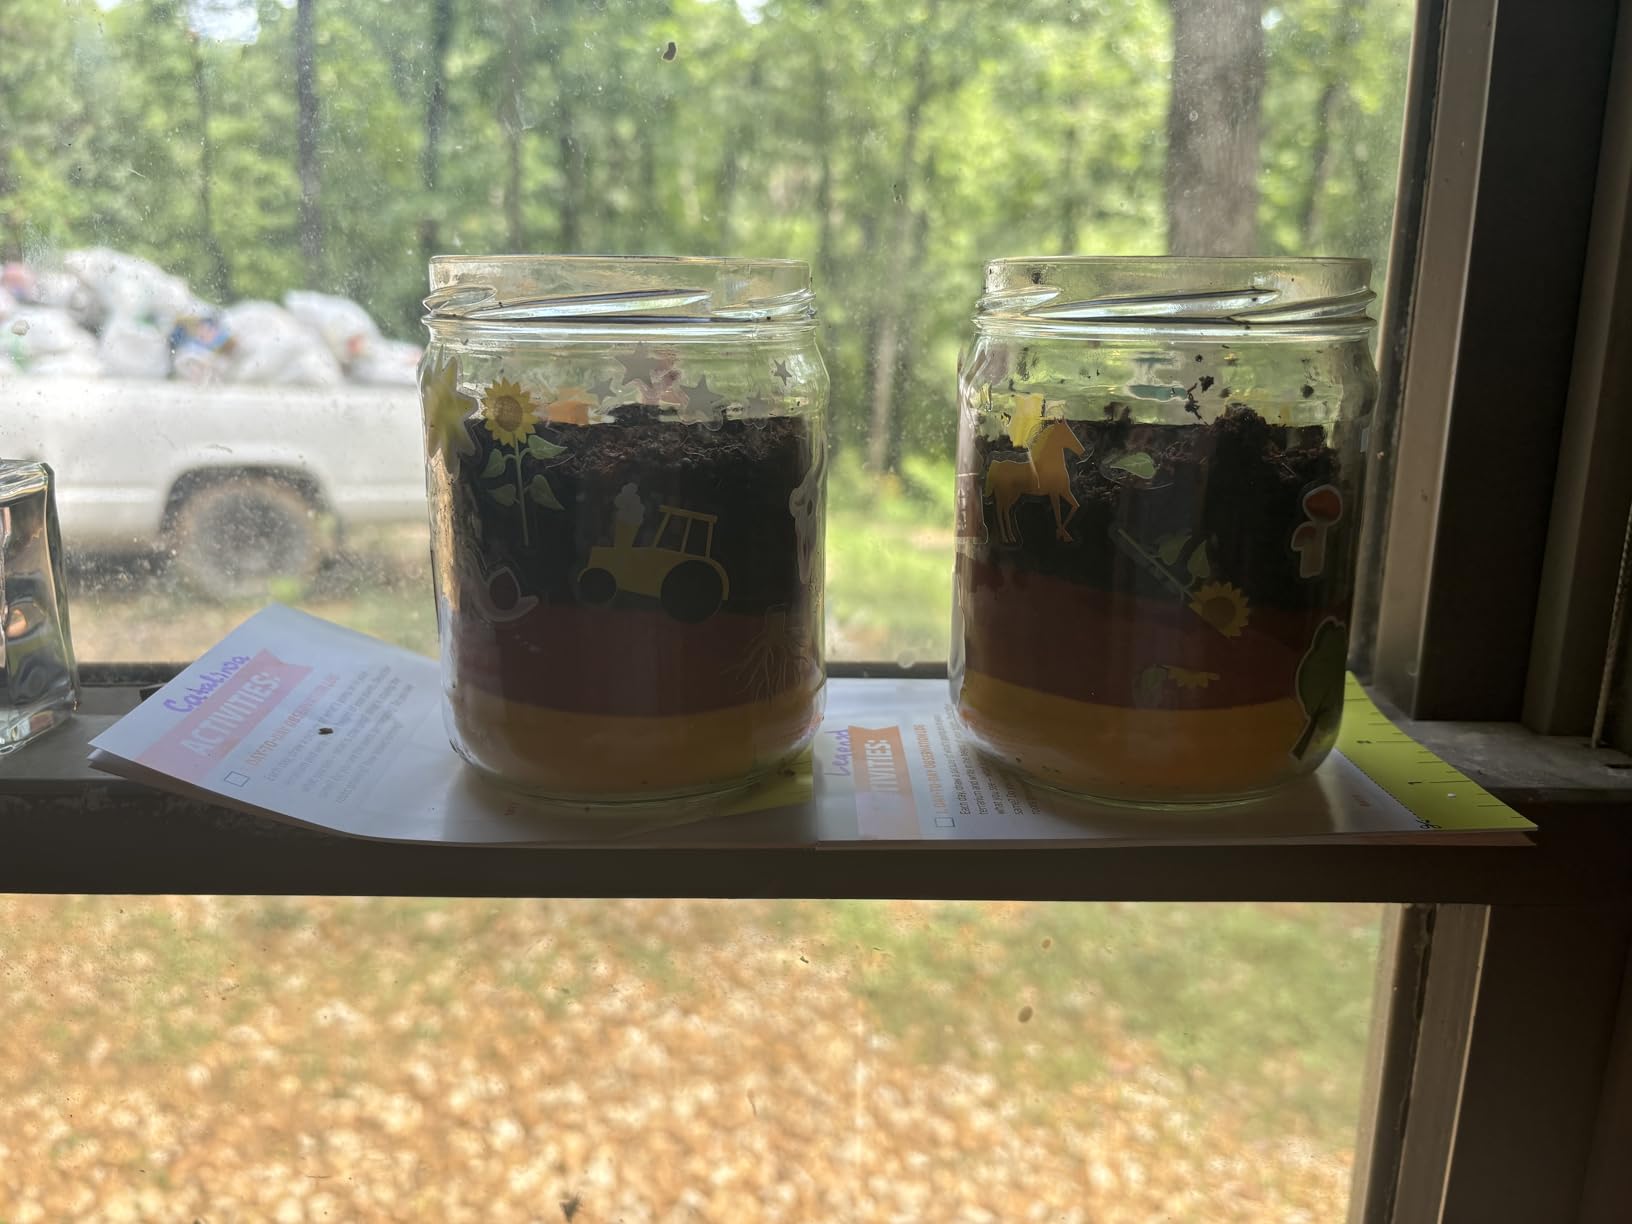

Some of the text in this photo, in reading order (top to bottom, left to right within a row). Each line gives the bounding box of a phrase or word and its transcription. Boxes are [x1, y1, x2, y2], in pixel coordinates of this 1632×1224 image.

[163, 655, 250, 713] Catalina
[180, 671, 281, 755] ACTIVITIES:
[863, 738, 898, 793] TIVITIES:
[969, 781, 981, 790] and
[975, 791, 989, 815] terrarium
[959, 802, 970, 815] Each
